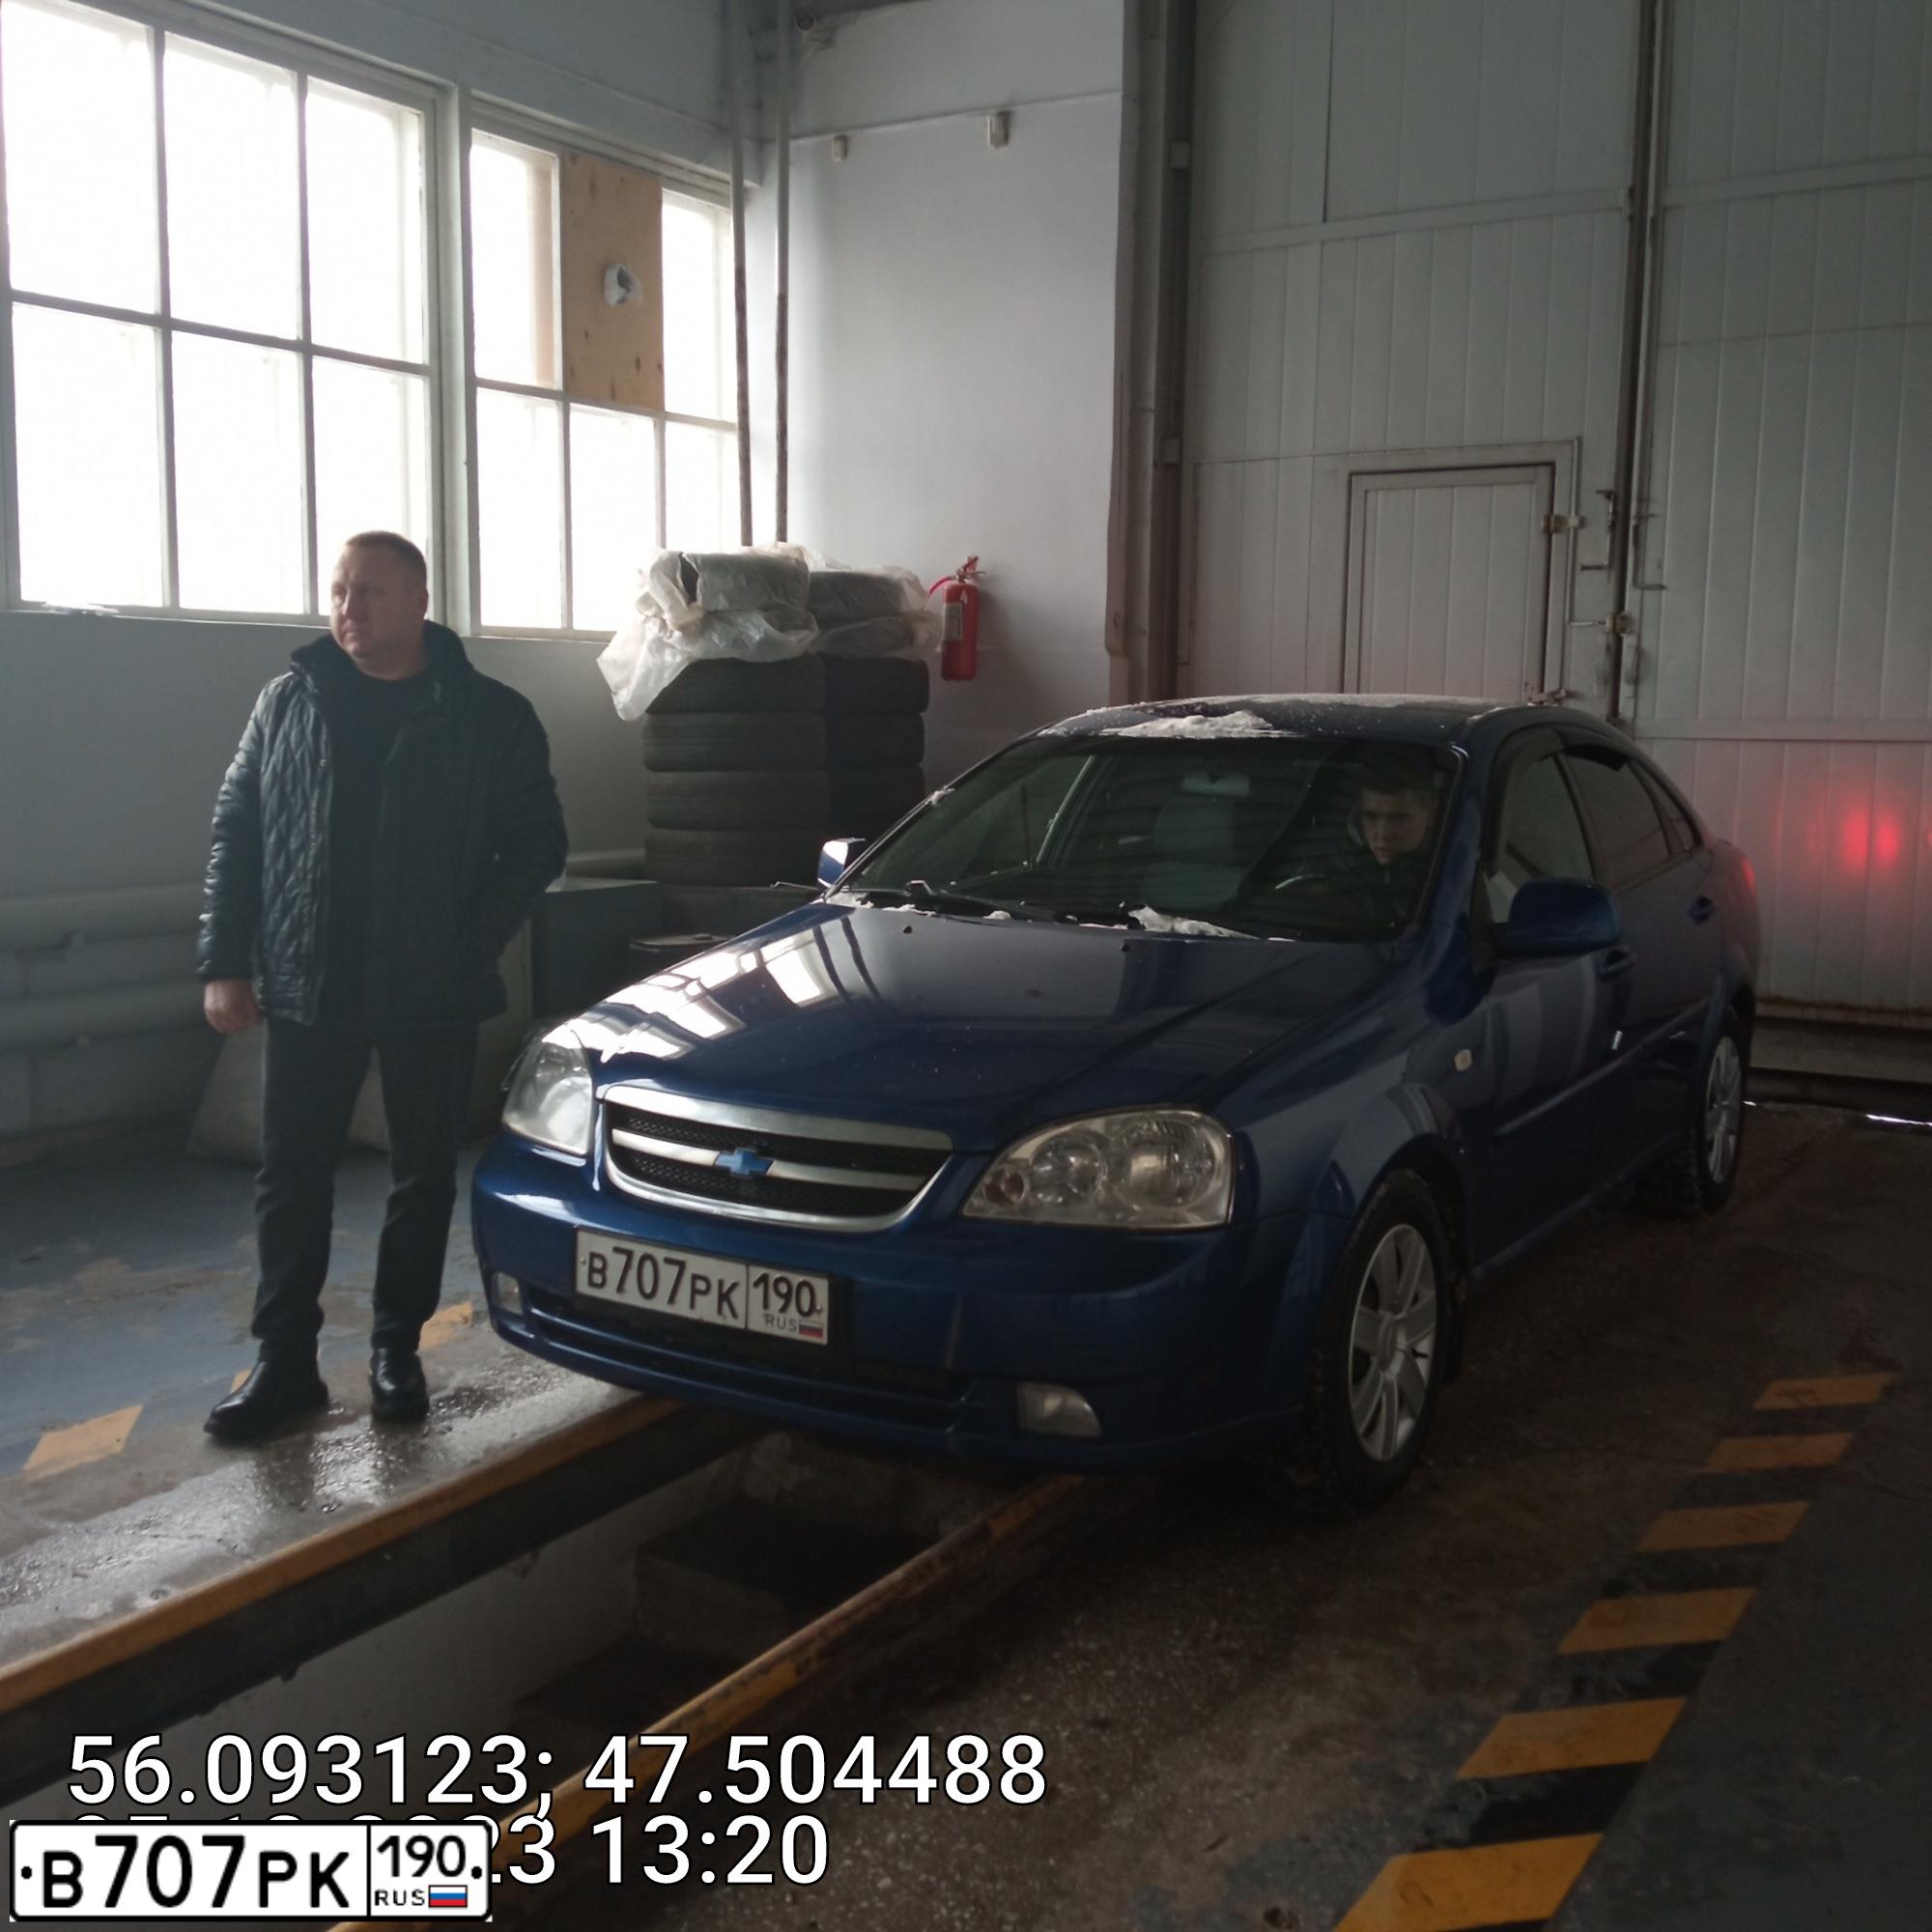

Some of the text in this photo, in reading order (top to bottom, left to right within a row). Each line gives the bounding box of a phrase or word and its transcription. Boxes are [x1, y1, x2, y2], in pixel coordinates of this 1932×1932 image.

[586, 1245, 816, 1320] В707РК 190
[763, 1313, 798, 1333] RUS
